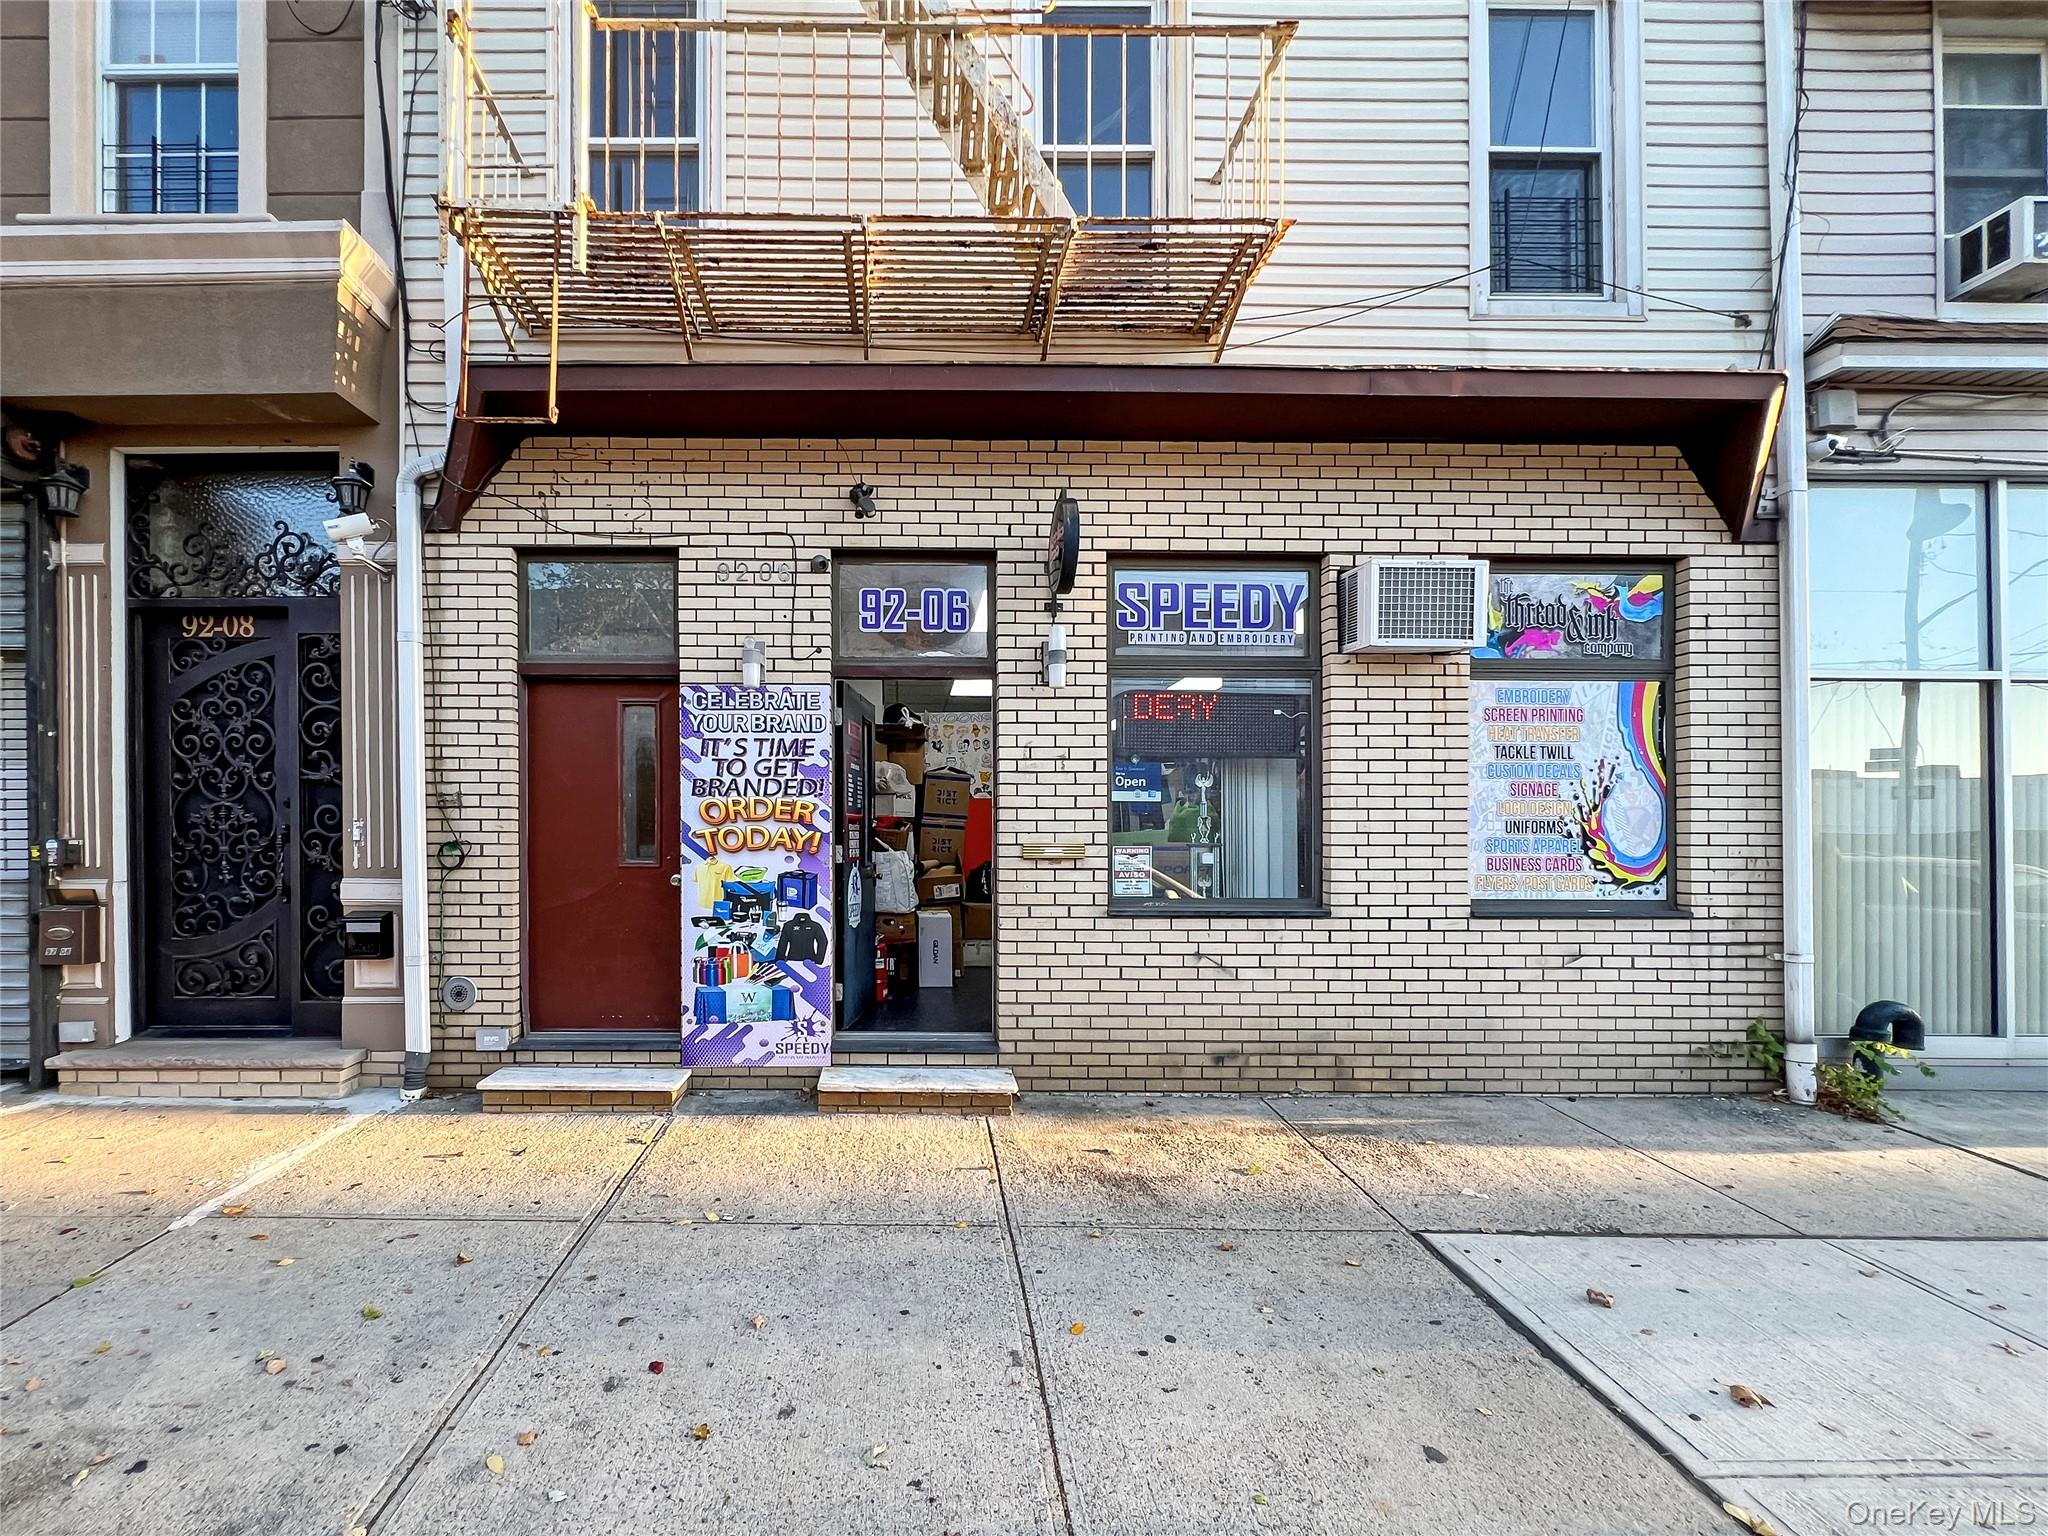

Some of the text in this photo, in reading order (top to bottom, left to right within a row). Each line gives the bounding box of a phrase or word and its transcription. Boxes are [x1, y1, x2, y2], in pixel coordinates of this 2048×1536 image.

[717, 562, 792, 582] 9206
[859, 588, 969, 633] 92-06
[1116, 582, 1305, 631] SPEEDY
[182, 615, 255, 638] 92-08
[1566, 605, 1587, 643] &
[1130, 633, 1293, 644] PRINTING AND EMBROIDERY
[692, 692, 821, 710] CELEBRATE
[1497, 689, 1571, 703] EMBROIDERY
[1484, 708, 1584, 722] SCREEN PRINTING
[689, 714, 827, 733] YOUR BRAND
[1488, 727, 1579, 741] HEAT TRANSFER
[754, 738, 816, 757] TIME
[1494, 745, 1574, 760] TACKLE TWILL
[712, 758, 806, 777] TO GET
[1487, 764, 1581, 778] CUSTOM DECALS
[691, 778, 825, 797] BRANDED!
[1115, 776, 1146, 788] Open
[1510, 782, 1558, 797] SIGNAGE
[699, 796, 816, 825] ORDER
[1497, 801, 1571, 816] LOGO DESIGN
[1505, 820, 1564, 834] UNIFORMS
[693, 825, 822, 856] TODAY!
[1486, 838, 1584, 853] SPORTS APPAREL
[1486, 857, 1583, 872] BUSINESS CARDS
[1556, 875, 1595, 891] CARDS
[741, 992, 756, 1003] W
[776, 1043, 829, 1054] SPEEDY
